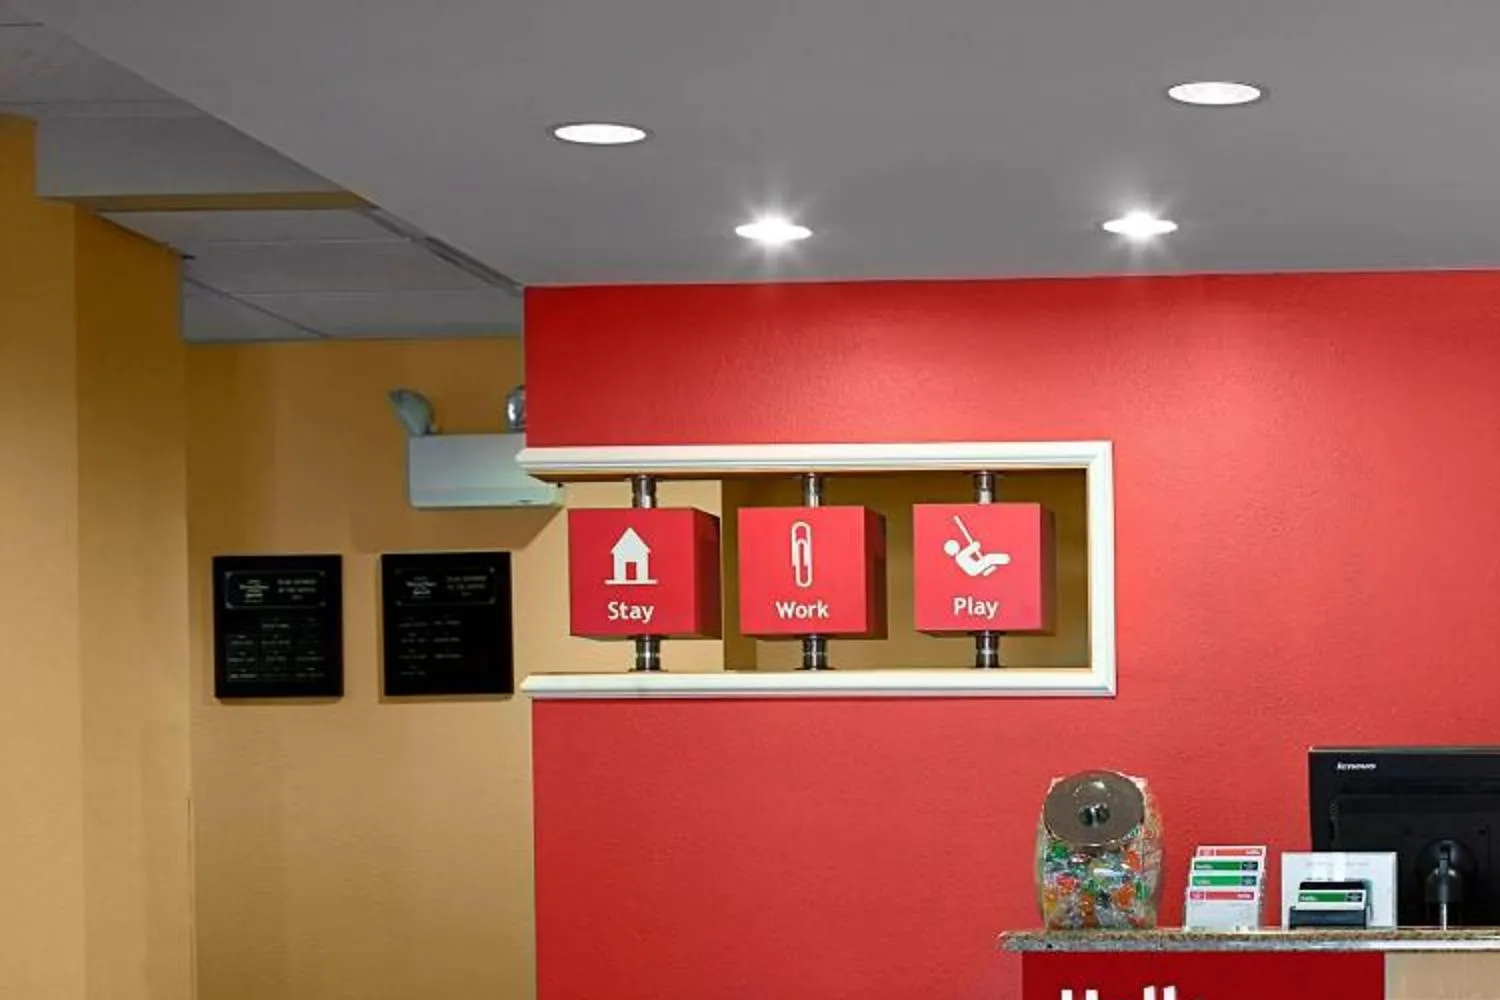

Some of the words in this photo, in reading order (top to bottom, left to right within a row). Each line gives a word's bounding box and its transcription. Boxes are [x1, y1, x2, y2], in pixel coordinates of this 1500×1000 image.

[607, 601, 655, 623] Stay
[775, 600, 830, 620] Work
[953, 596, 999, 619] Play
